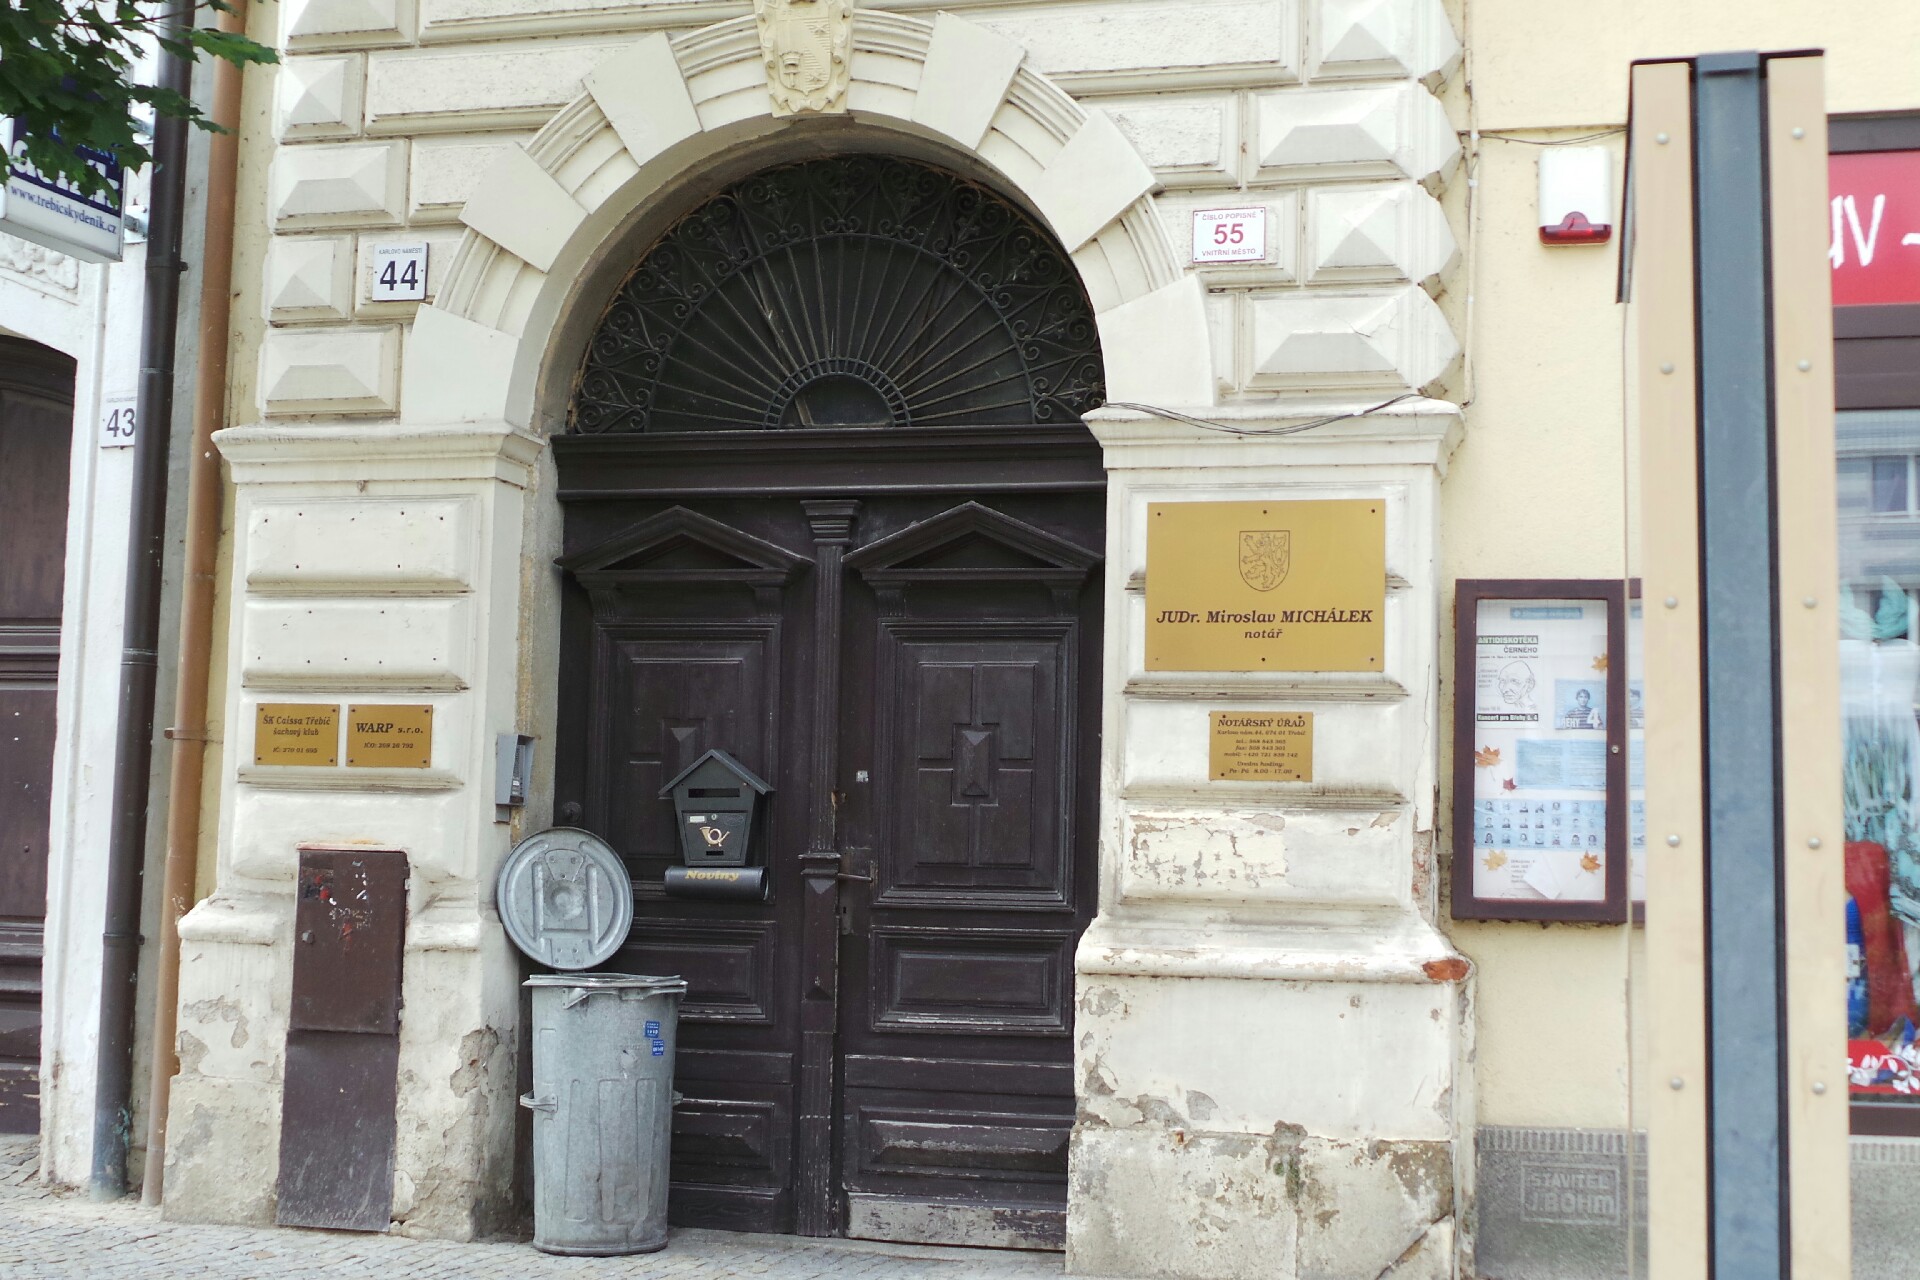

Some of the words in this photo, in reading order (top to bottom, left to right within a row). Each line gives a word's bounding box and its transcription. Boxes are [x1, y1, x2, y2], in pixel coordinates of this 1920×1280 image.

[11, 184, 117, 235] www.trebicskydenik.cz
[1214, 223, 1244, 245] 55
[380, 260, 419, 291] 44
[106, 408, 135, 437] 43
[1156, 609, 1201, 624] JUDr.
[1206, 610, 1276, 624] Miroslav
[1280, 607, 1373, 624] MICHÁLEK
[1244, 628, 1283, 640] notář
[276, 715, 304, 725] Caissa
[1217, 717, 1274, 727] NOTÁŘSKÝ
[1277, 717, 1306, 728] ÚŘAD
[303, 728, 319, 736] klub
[356, 722, 394, 733] WARP
[685, 870, 740, 882] Noviny
[1530, 1173, 1610, 1189] STAVITEL
